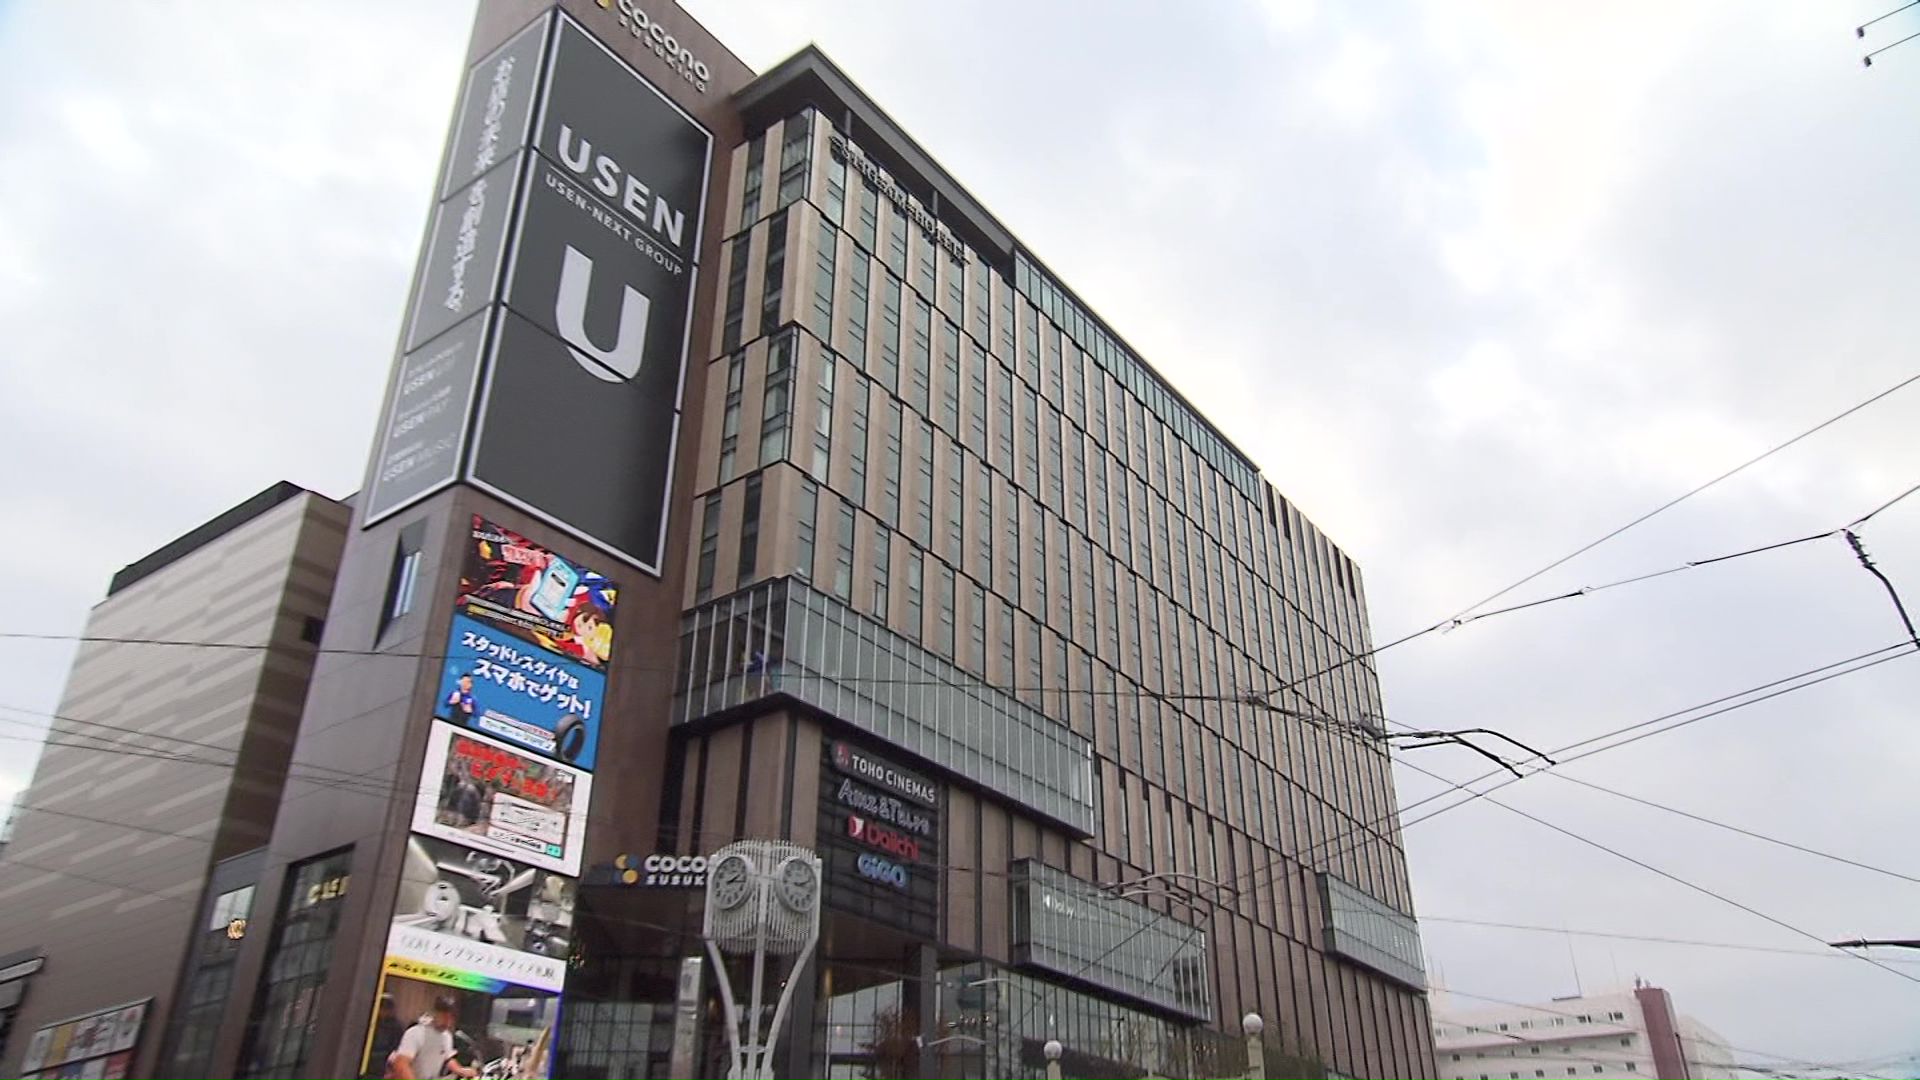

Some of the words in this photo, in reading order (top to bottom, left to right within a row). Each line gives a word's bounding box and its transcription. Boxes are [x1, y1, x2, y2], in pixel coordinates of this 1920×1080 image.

[557, 124, 686, 247] USEN
[545, 174, 632, 240] USEN-NEXT
[635, 236, 683, 276] GROUP
[462, 631, 580, 690] スタッドレスタイヤは
[852, 755, 884, 782] TOHO
[886, 769, 936, 804] CINEMAS
[867, 822, 921, 861] Daiichi
